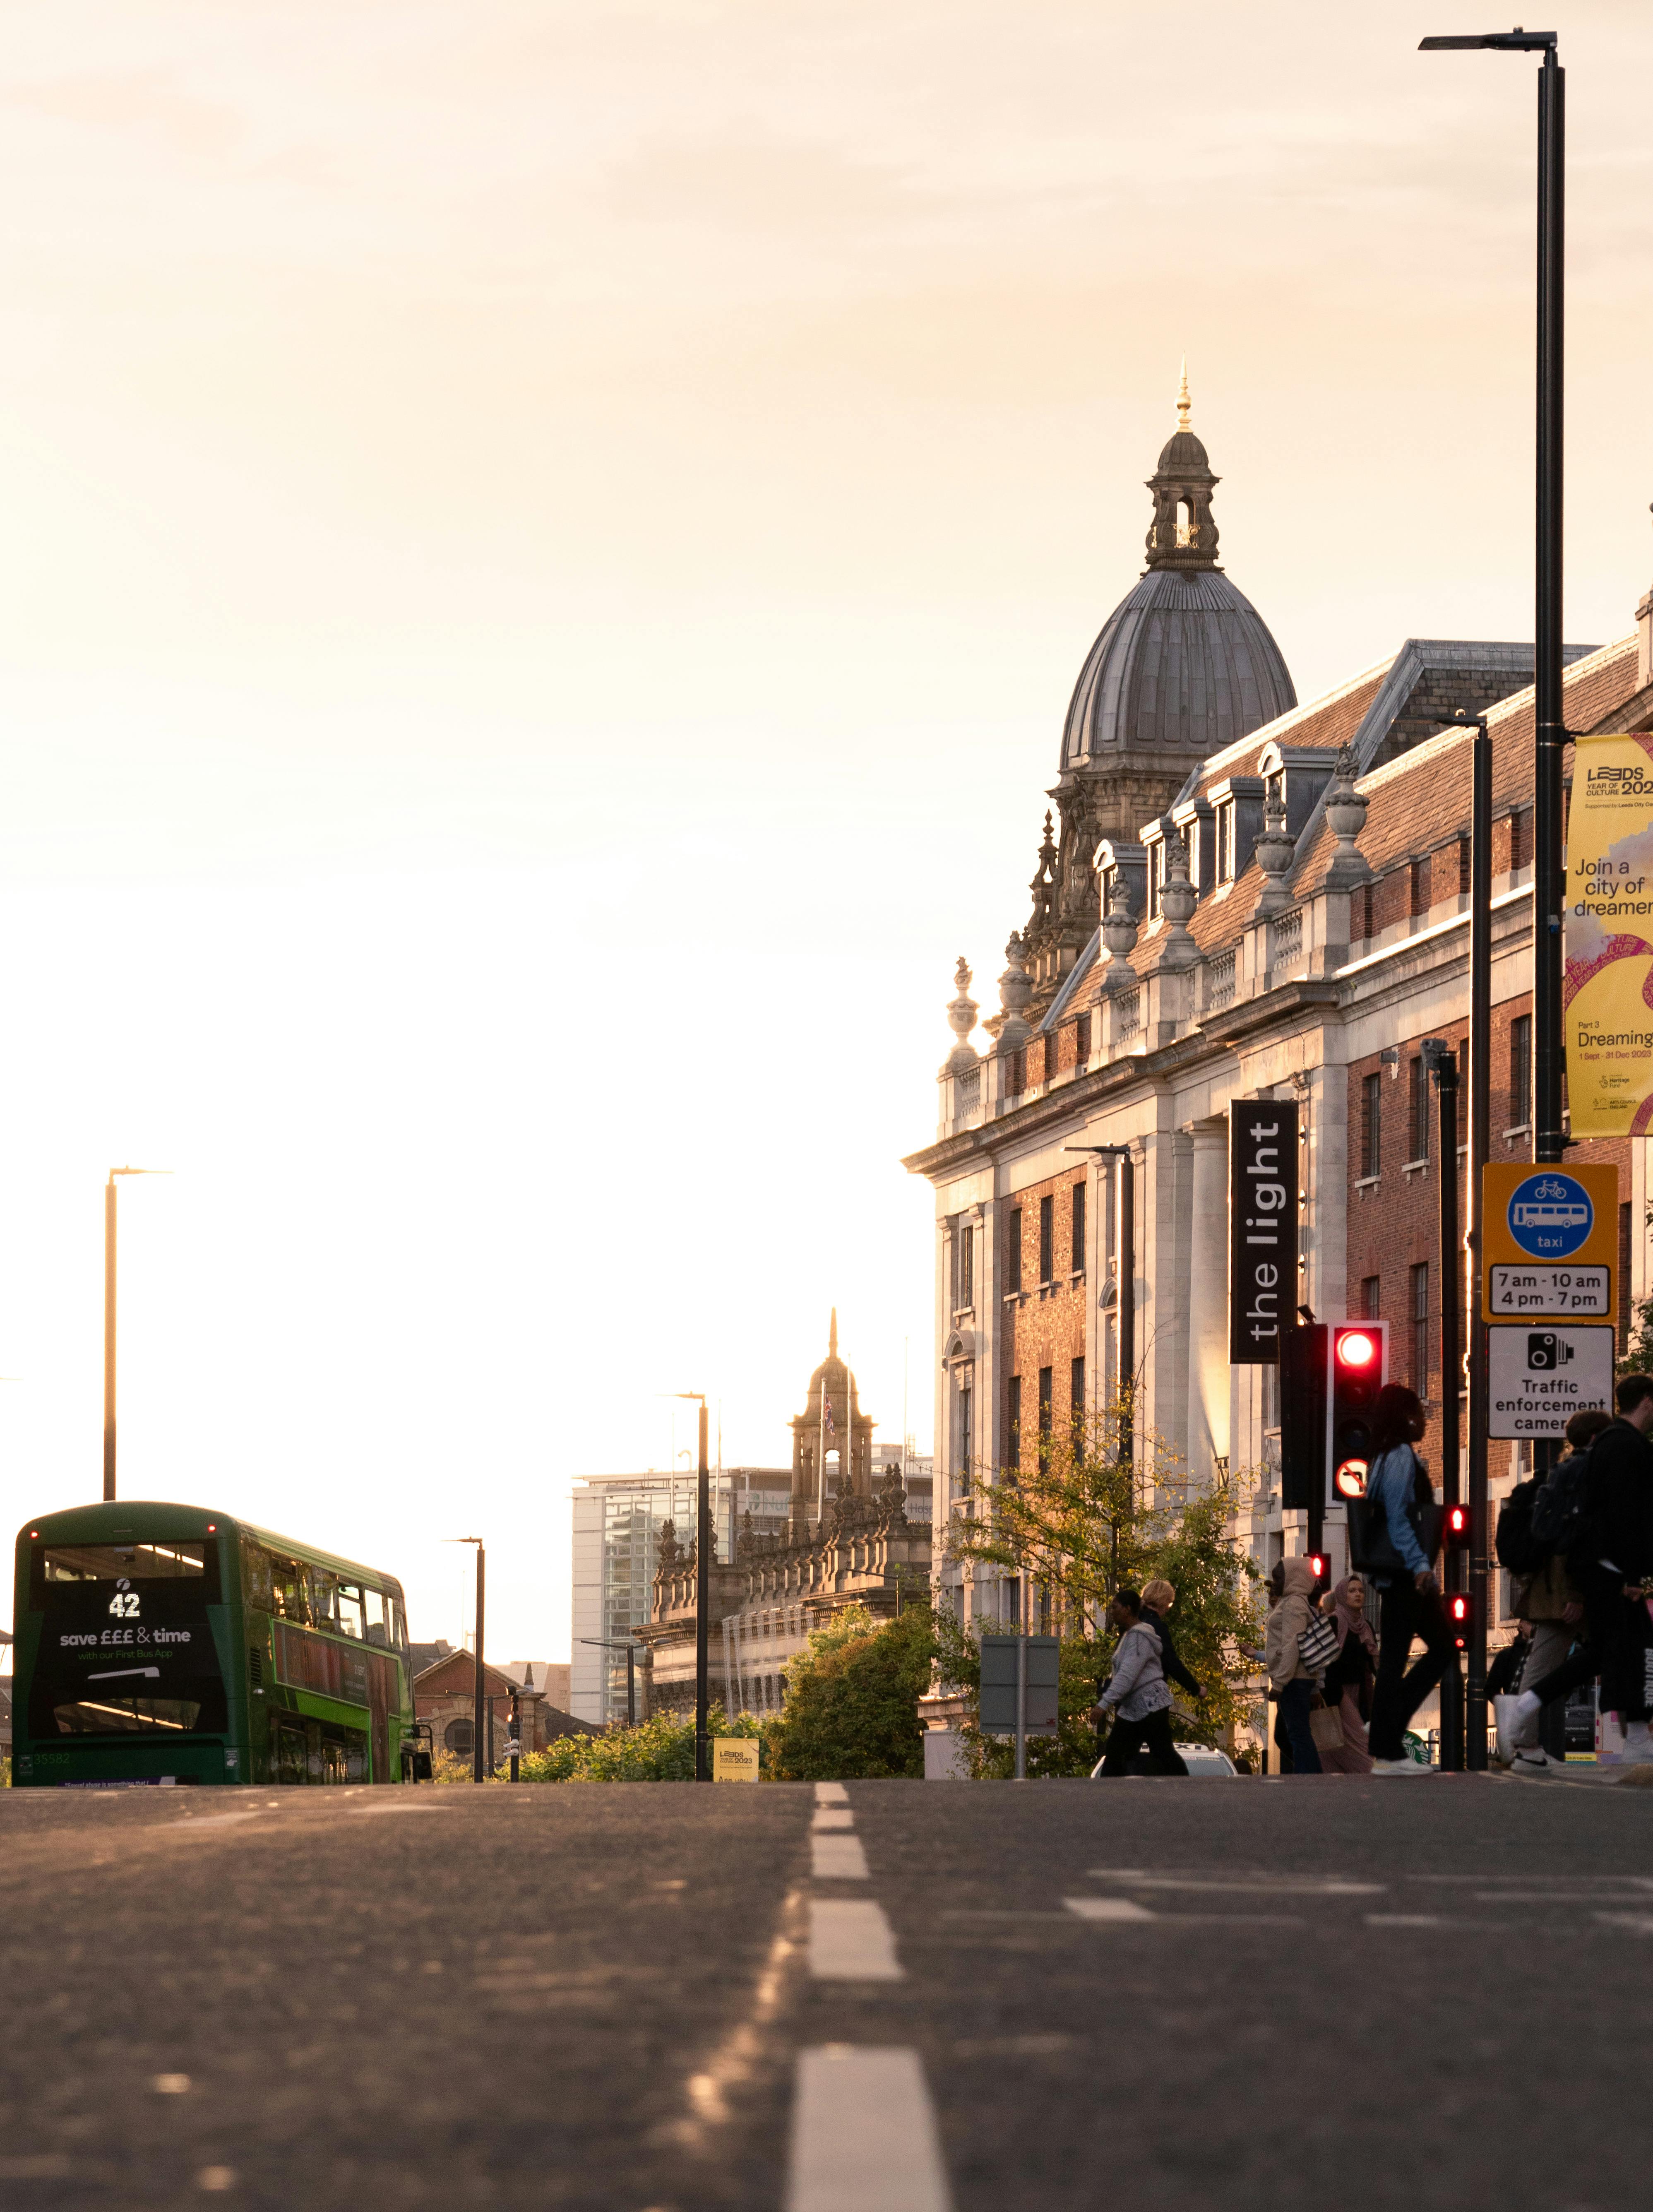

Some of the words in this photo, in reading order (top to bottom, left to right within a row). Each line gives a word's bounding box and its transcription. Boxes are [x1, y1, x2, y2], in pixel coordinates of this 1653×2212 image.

[1588, 766, 1644, 781] LEEDS
[1575, 858, 1612, 875] Join
[1619, 862, 1629, 874] a
[1585, 878, 1619, 899] city
[1625, 877, 1645, 894] of
[1578, 1030, 1653, 1048] Dreaming
[1584, 1052, 1600, 1061] Sept
[1246, 1122, 1286, 1244] light
[1537, 1236, 1563, 1248] taxi
[1498, 1273, 1509, 1286] 7
[1512, 1276, 1537, 1287] am
[1552, 1273, 1571, 1287] 10
[1576, 1277, 1601, 1287] am
[1246, 1263, 1278, 1341] the
[1502, 1291, 1514, 1305] 4
[1518, 1294, 1544, 1308] pm
[1558, 1292, 1568, 1305] 7
[1572, 1295, 1597, 1308] pm
[1522, 1379, 1579, 1394] Traffic
[1495, 1397, 1606, 1412] enforcement
[1514, 1418, 1567, 1430] camer
[109, 1593, 140, 1617] 42
[60, 1634, 98, 1646] save
[101, 1629, 134, 1645] £££
[137, 1627, 151, 1643] &
[153, 1628, 191, 1643] time
[78, 1651, 98, 1660] with
[116, 1650, 135, 1659] First
[137, 1649, 153, 1658] Bus
[155, 1649, 173, 1659] App
[34, 1753, 70, 1765] 35582
